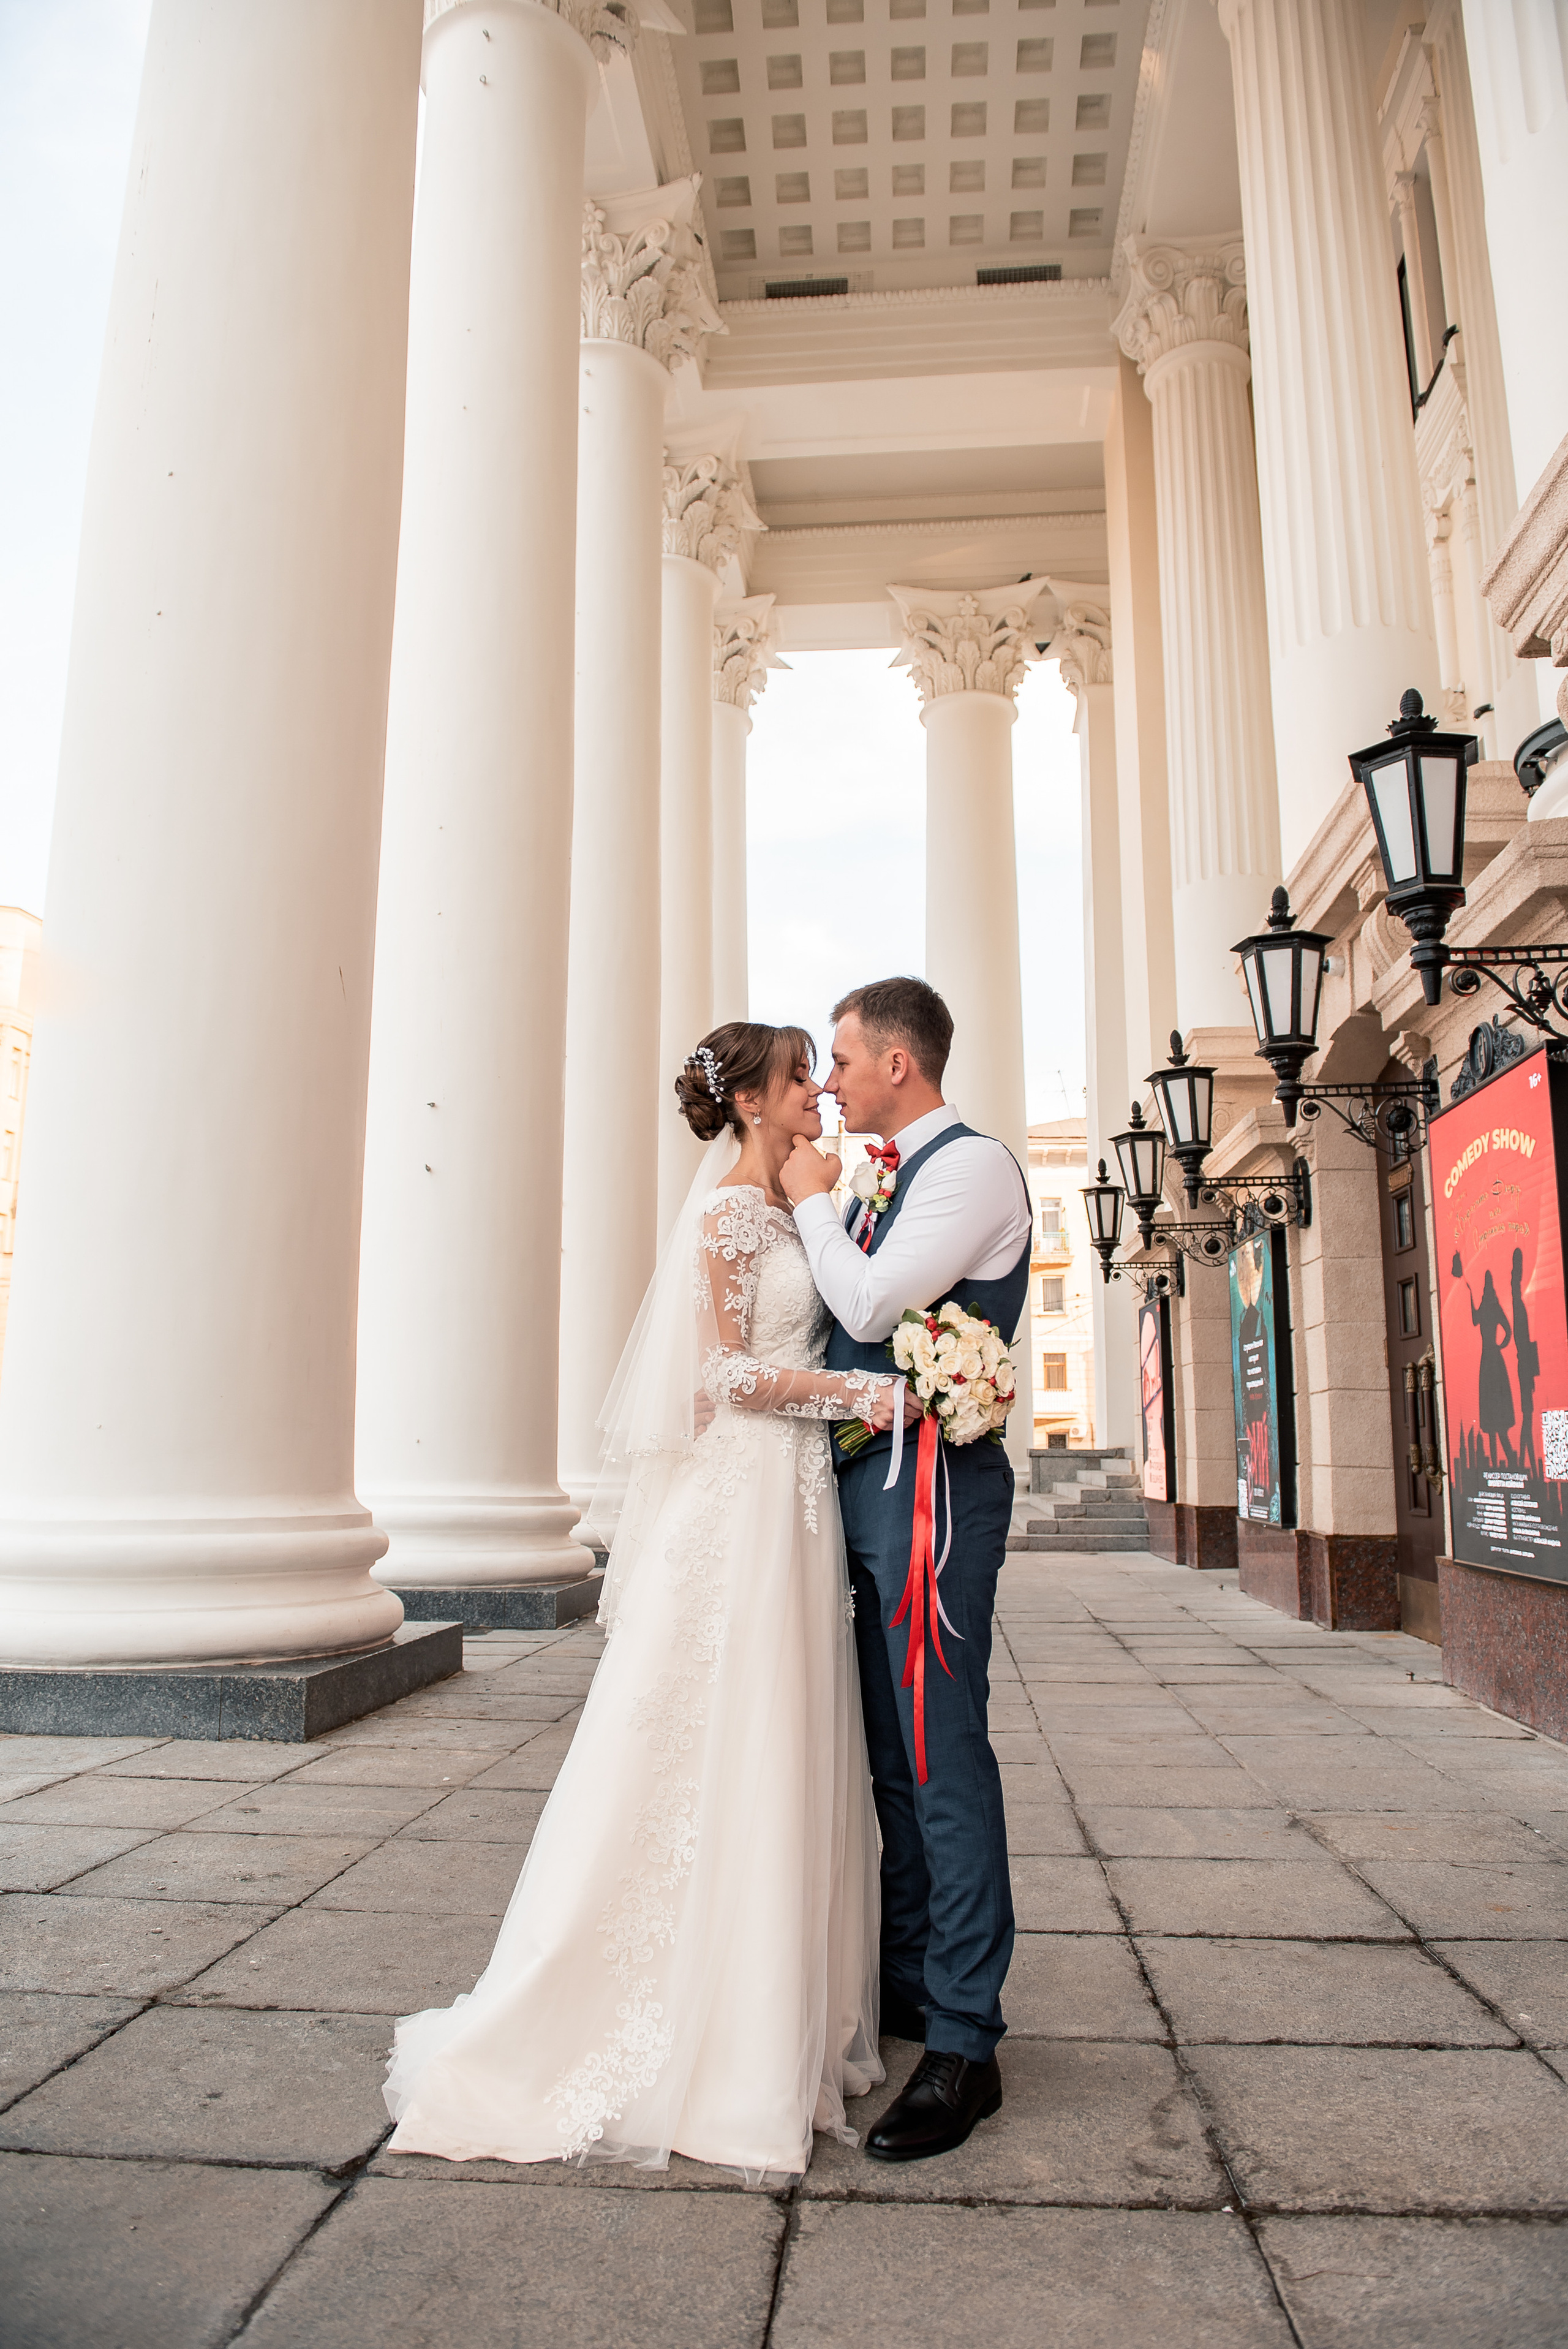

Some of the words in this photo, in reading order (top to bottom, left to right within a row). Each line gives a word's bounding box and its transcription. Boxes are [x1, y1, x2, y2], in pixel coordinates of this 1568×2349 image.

[1528, 1073, 1542, 1089] 16+
[1444, 1132, 1490, 1198] COMEDY
[1492, 1128, 1536, 1159] SHOW
